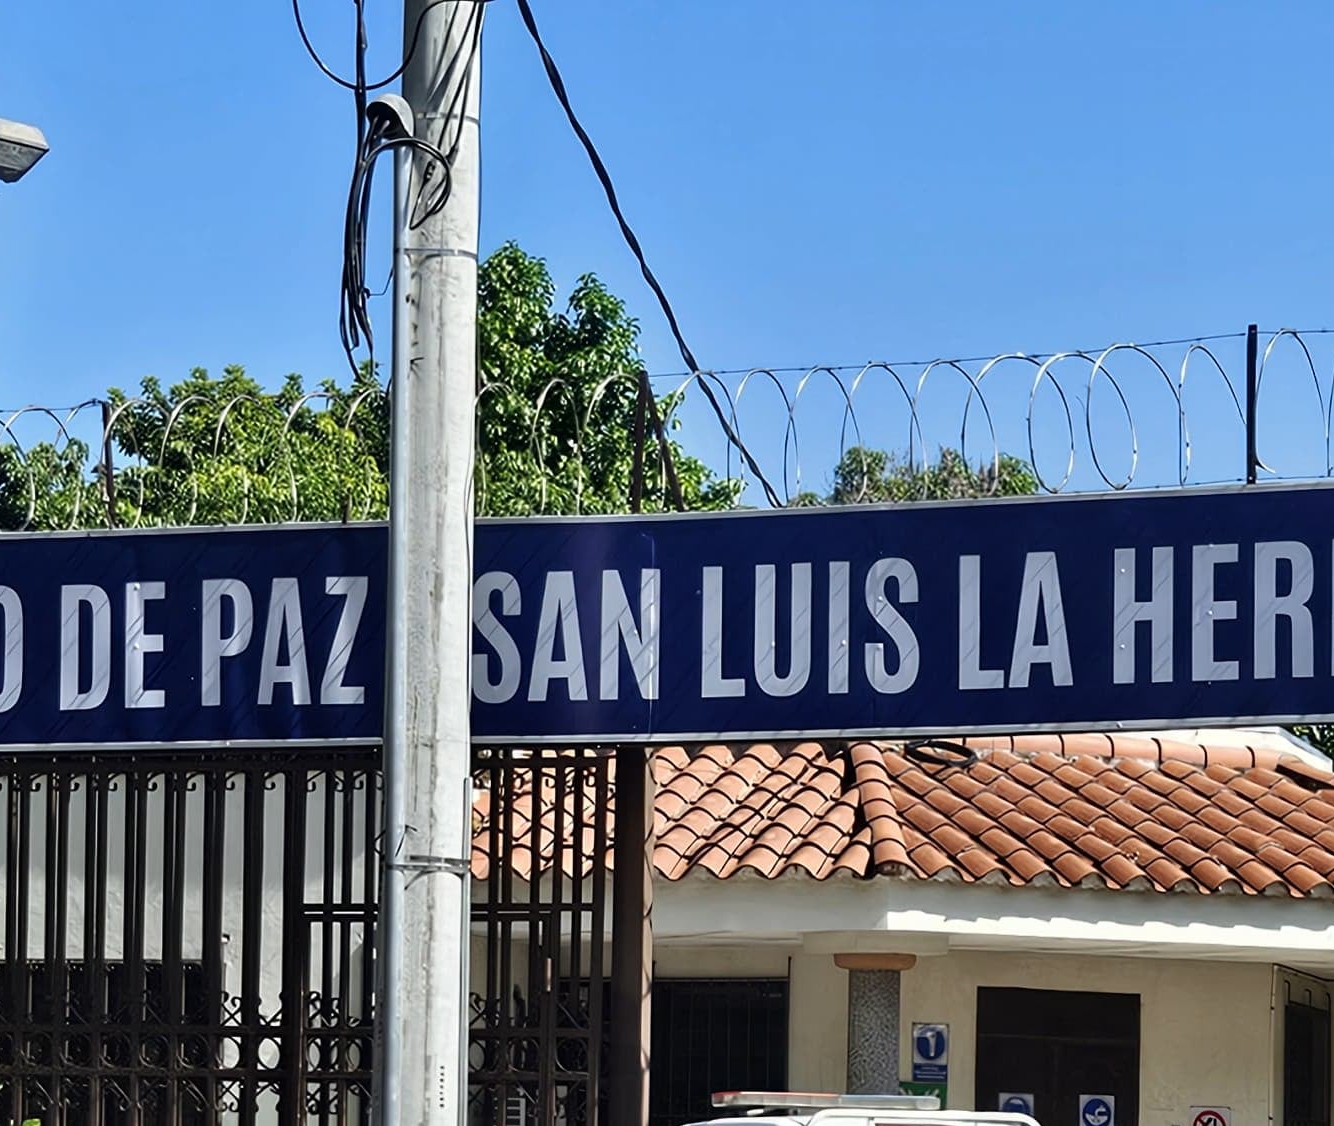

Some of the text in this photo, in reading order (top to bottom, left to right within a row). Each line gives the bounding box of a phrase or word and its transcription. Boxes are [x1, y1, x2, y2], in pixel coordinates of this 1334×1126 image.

[59, 580, 166, 712] DE
[199, 574, 370, 708] PAZ
[471, 567, 662, 705] SAN
[700, 556, 921, 698] LUIS
[957, 550, 1074, 691] LA
